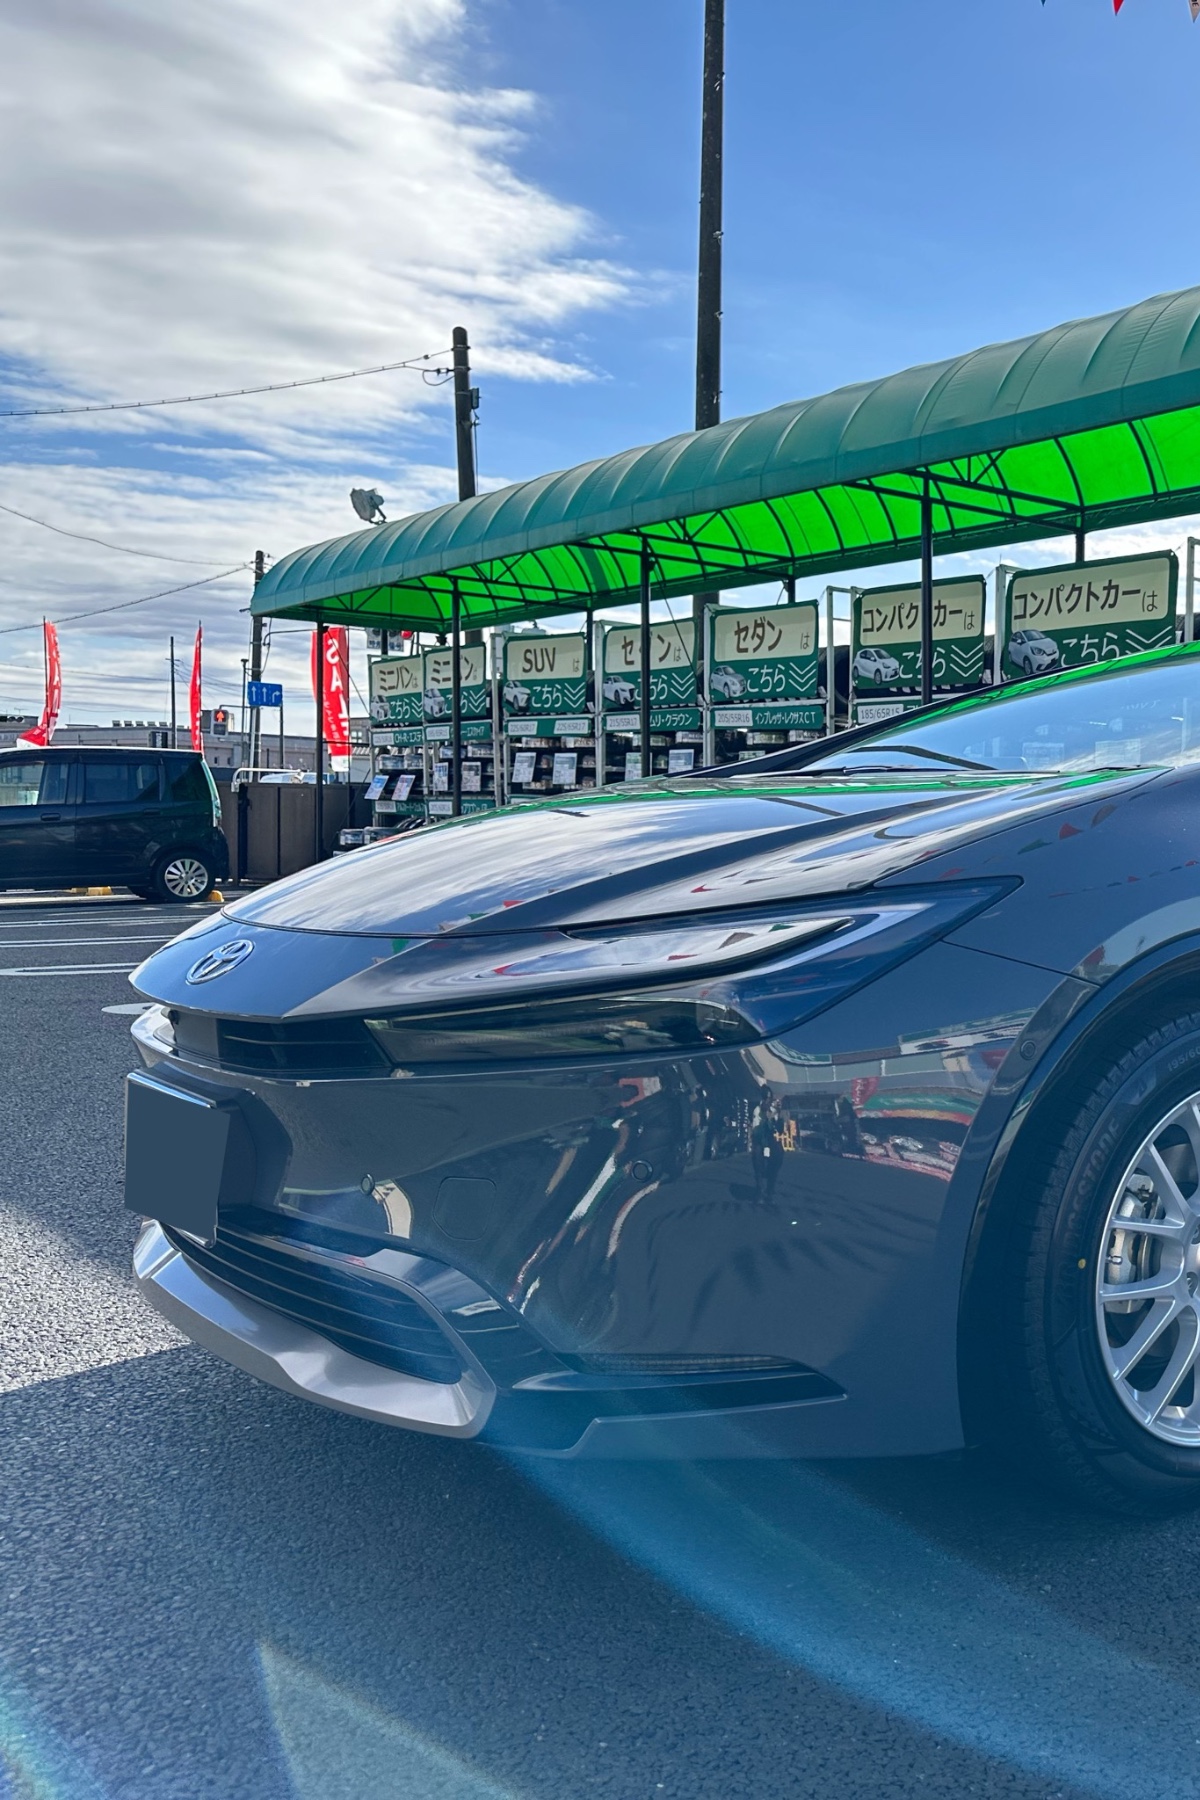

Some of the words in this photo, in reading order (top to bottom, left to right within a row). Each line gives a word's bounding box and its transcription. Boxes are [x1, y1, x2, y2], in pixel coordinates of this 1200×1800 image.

[862, 599, 976, 633] コンパクカーは
[1013, 579, 1159, 621] コンパクトカーは
[621, 634, 682, 666] センは
[734, 616, 783, 653] セダン
[522, 647, 556, 673] SUV
[746, 664, 787, 693] こちら
[531, 683, 563, 708] こちら
